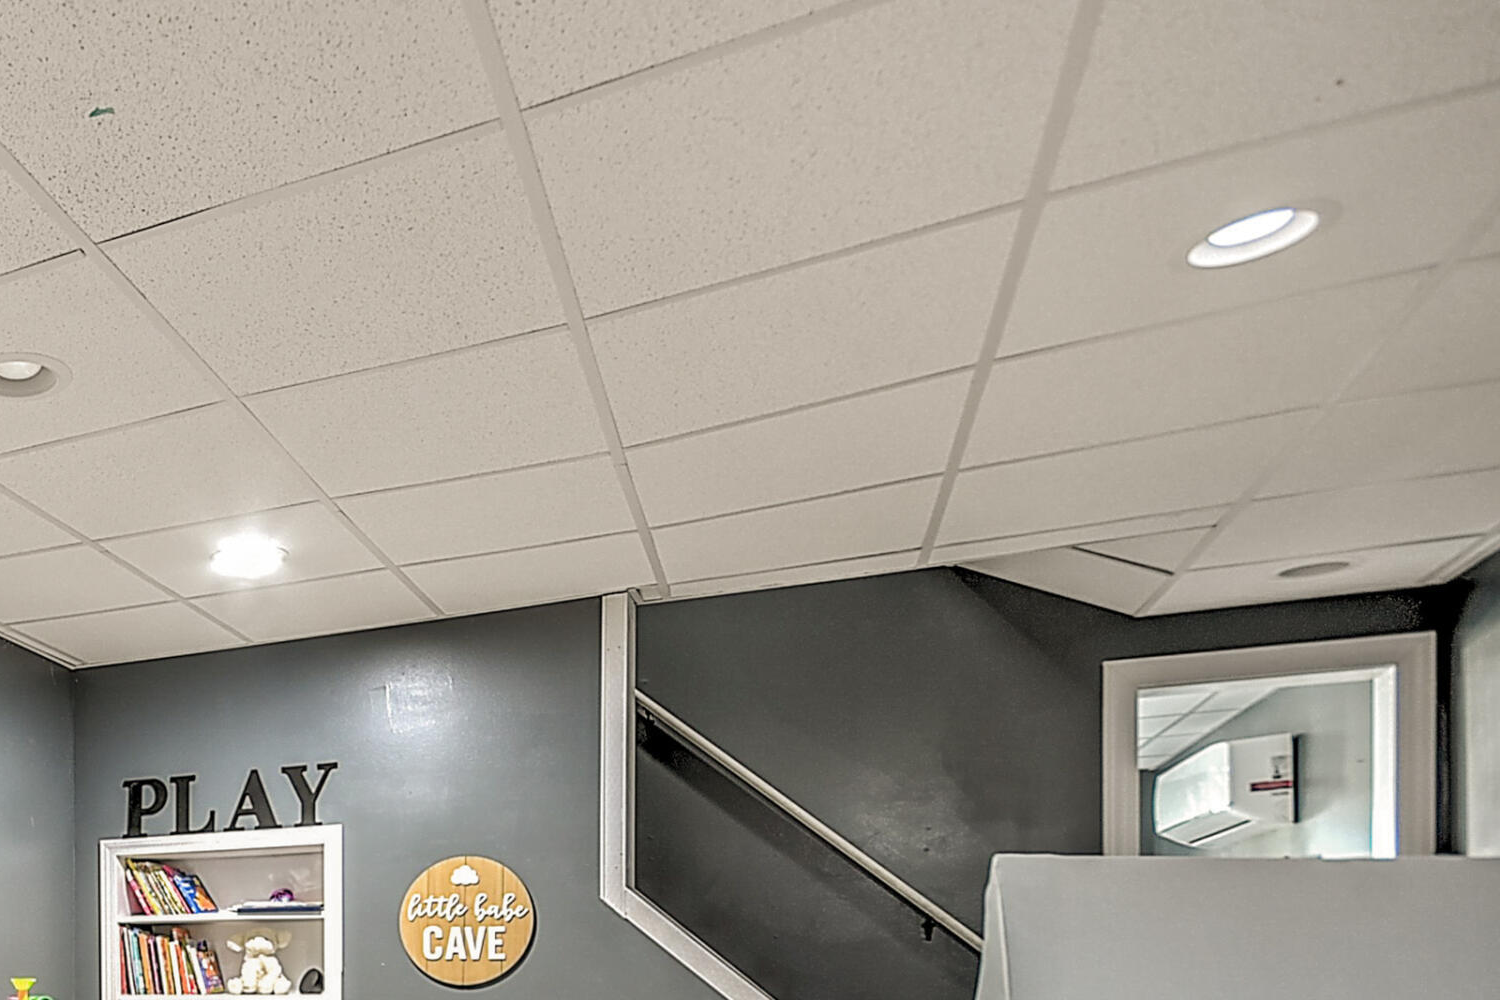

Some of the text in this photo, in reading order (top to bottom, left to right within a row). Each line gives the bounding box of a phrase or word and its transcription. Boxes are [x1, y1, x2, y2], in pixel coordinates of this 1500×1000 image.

[122, 762, 338, 838] PLAY
[407, 892, 529, 923] little babe
[422, 925, 506, 961] CAVE
